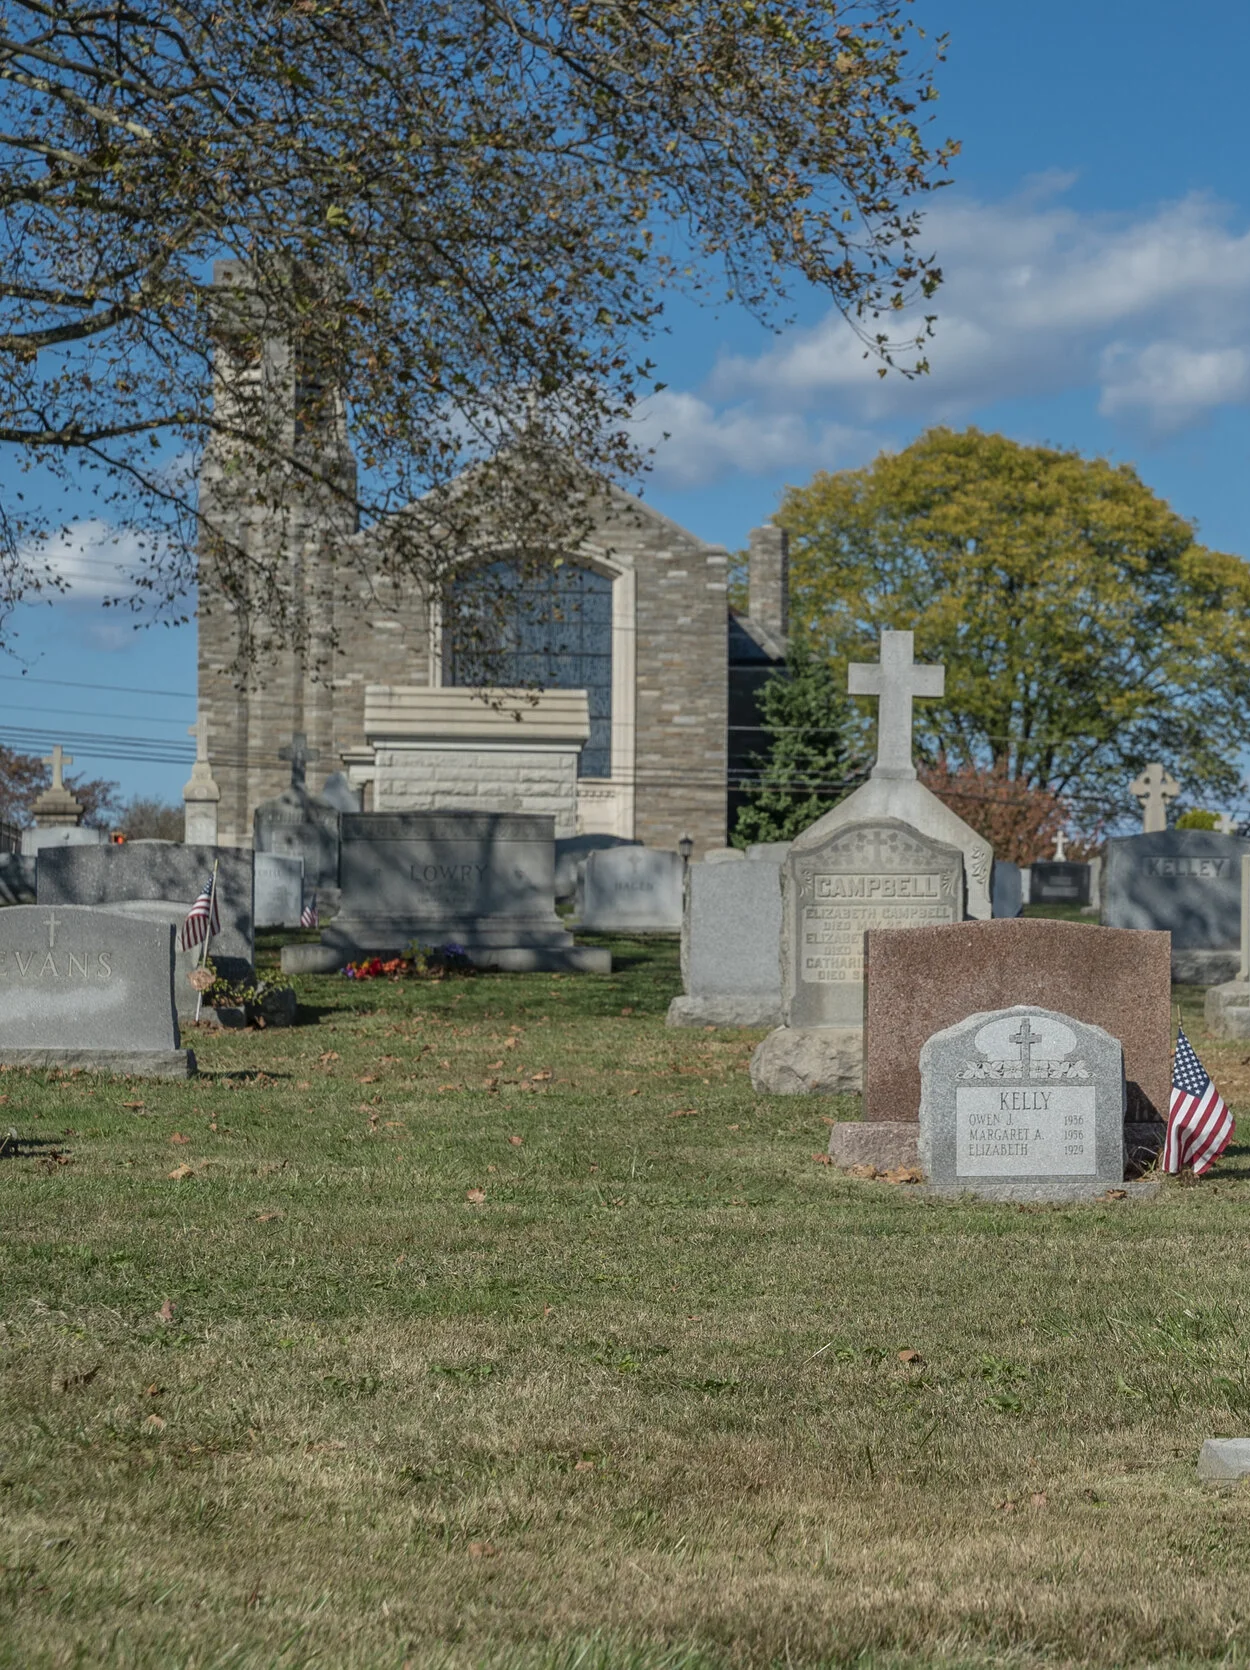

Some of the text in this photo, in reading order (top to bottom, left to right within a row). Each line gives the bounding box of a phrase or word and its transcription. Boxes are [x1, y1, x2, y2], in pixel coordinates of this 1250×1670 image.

[409, 864, 489, 882] LOWRY
[1147, 858, 1225, 877] KELLEY
[816, 876, 938, 899] CAMPBELL
[805, 908, 951, 920] ELIZABETH CAMPBELL
[823, 921, 851, 931] DIED
[824, 945, 852, 956] DIED
[0, 951, 113, 979] EVANS
[806, 957, 864, 969] CATHARI
[817, 970, 846, 980] DIED
[999, 1091, 1052, 1111] KELLY
[968, 1113, 1001, 1126] OWEN
[968, 1128, 1030, 1142] MARGARET
[1033, 1128, 1045, 1141] A.
[968, 1143, 1084, 1157] ELIZABETH 1929
